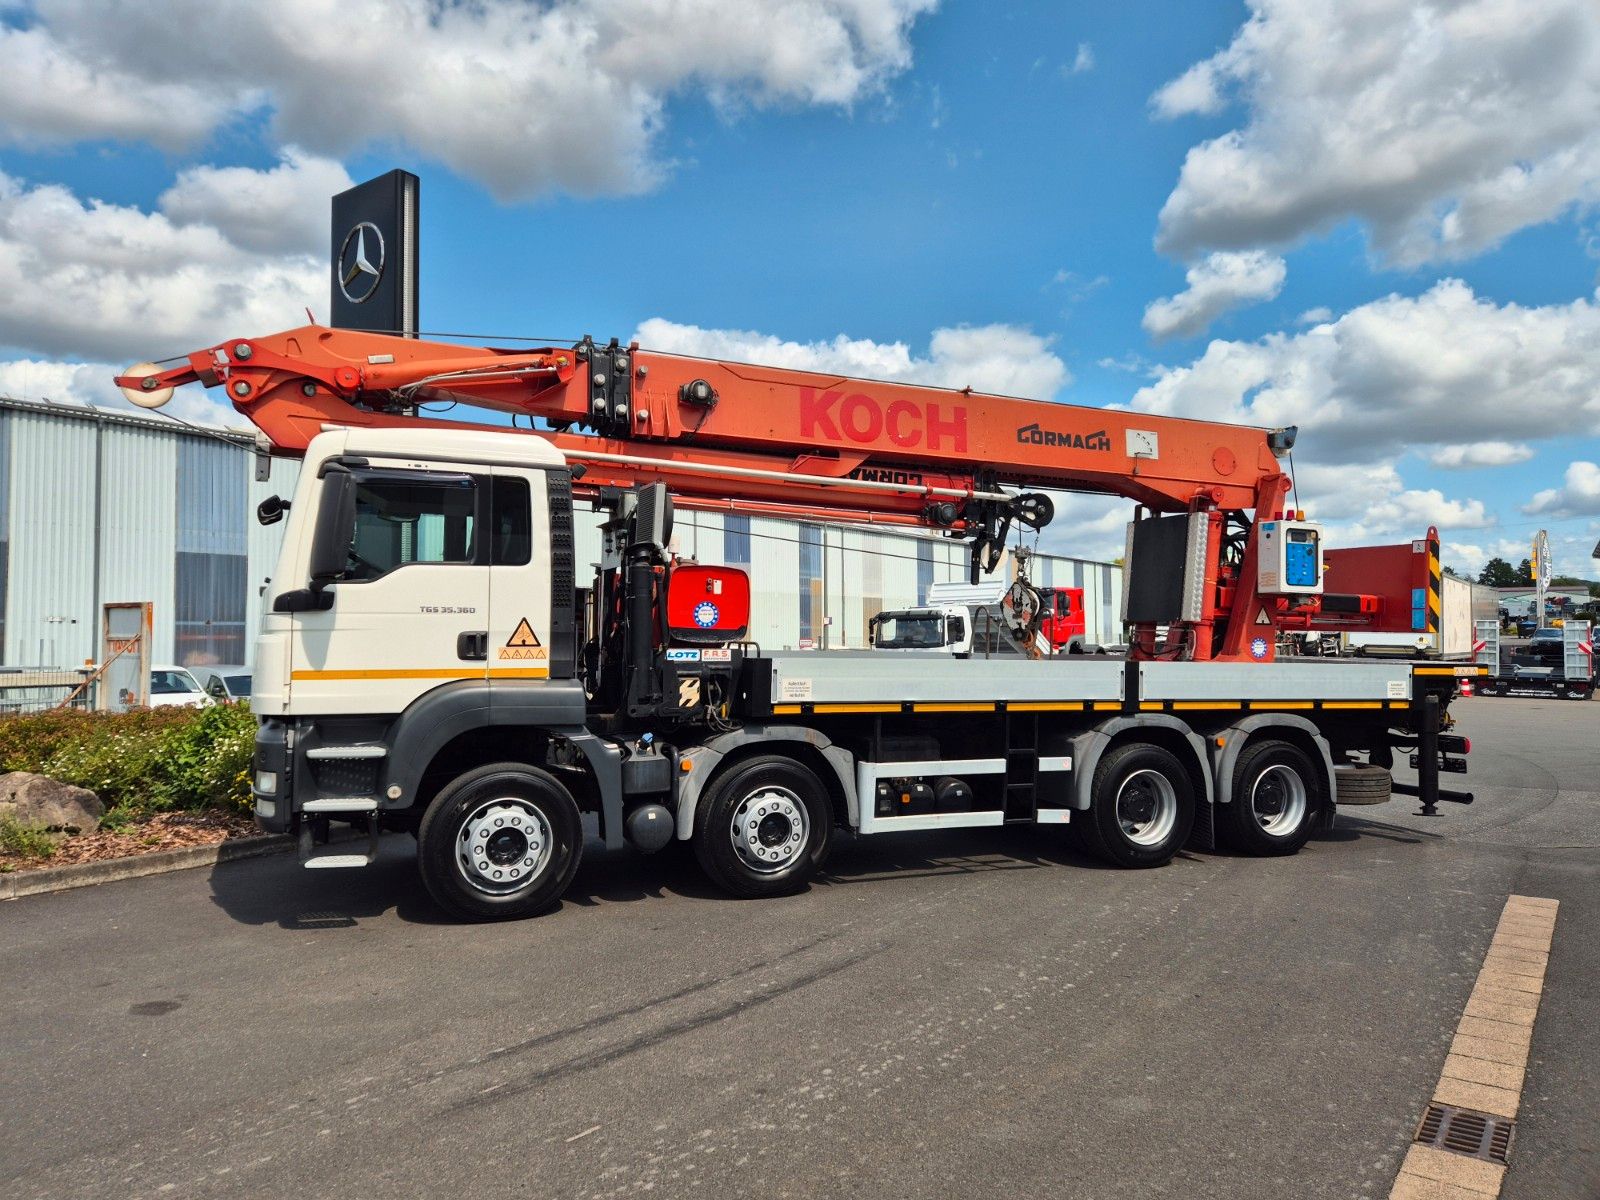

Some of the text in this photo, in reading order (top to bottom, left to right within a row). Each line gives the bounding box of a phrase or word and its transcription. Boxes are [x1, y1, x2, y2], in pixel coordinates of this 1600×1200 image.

[801, 387, 968, 453] KOCH
[420, 606, 476, 614] TGS 35.360
